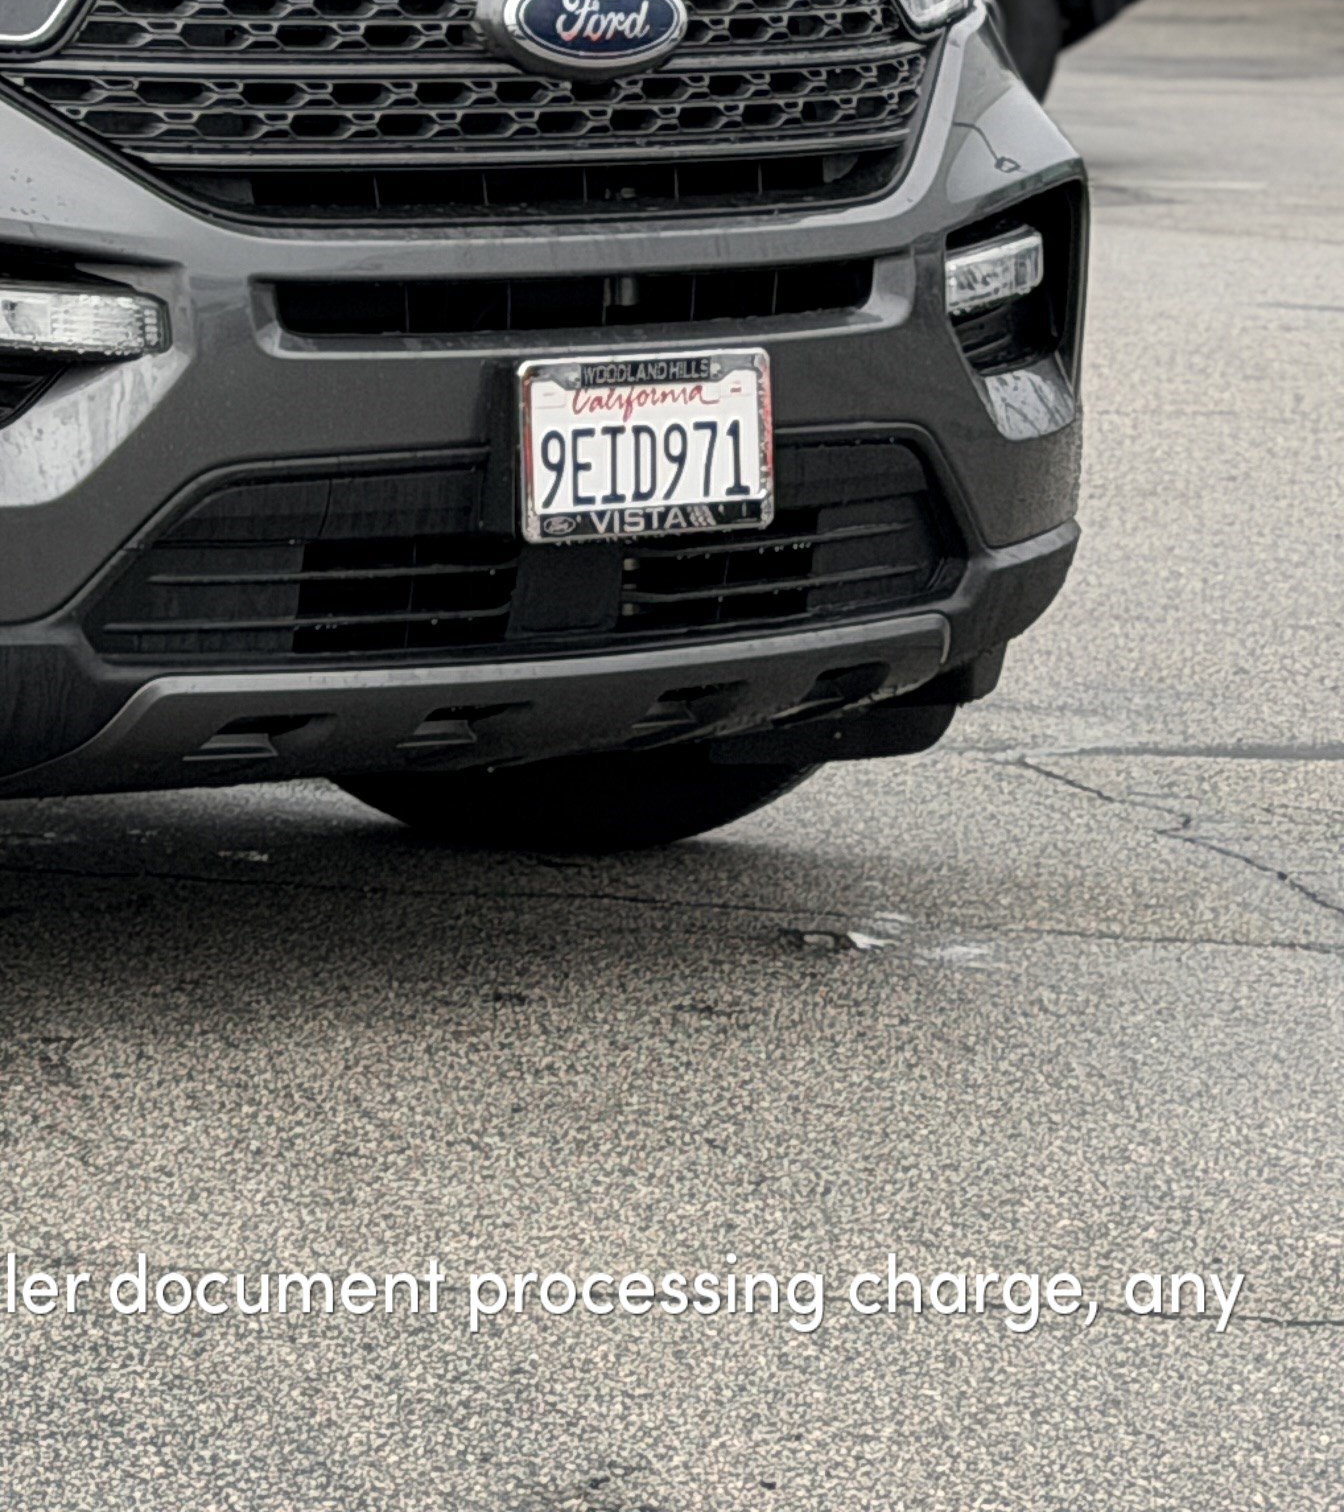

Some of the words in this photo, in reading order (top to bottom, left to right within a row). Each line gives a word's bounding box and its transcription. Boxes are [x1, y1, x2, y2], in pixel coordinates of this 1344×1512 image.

[583, 364, 668, 386] WOODLAND
[668, 359, 710, 380] HILLS
[571, 384, 721, 422] California
[540, 418, 751, 509] 9EID971
[590, 504, 688, 535] VISTA
